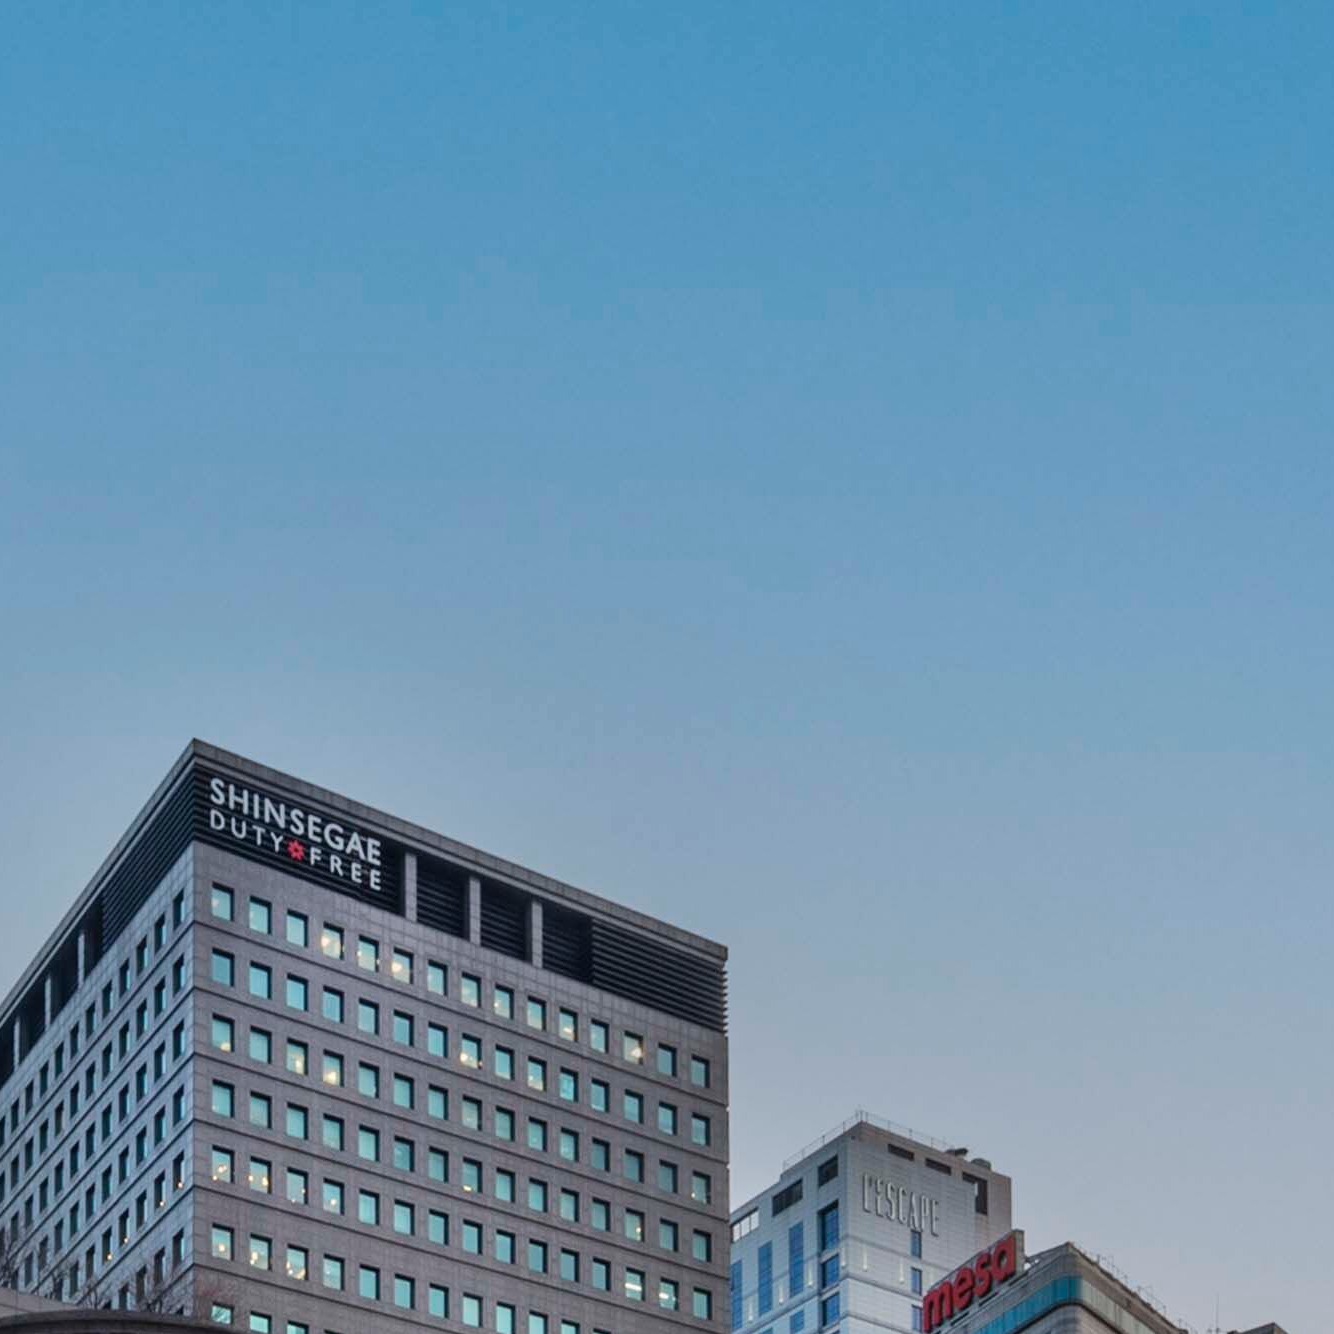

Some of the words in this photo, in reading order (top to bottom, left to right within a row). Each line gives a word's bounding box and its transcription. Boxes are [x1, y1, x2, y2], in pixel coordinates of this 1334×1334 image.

[210, 777, 382, 867] SHINSEGAE
[210, 808, 284, 854] DUTY
[308, 846, 382, 892] FREE
[922, 1233, 1017, 1334] mesa
